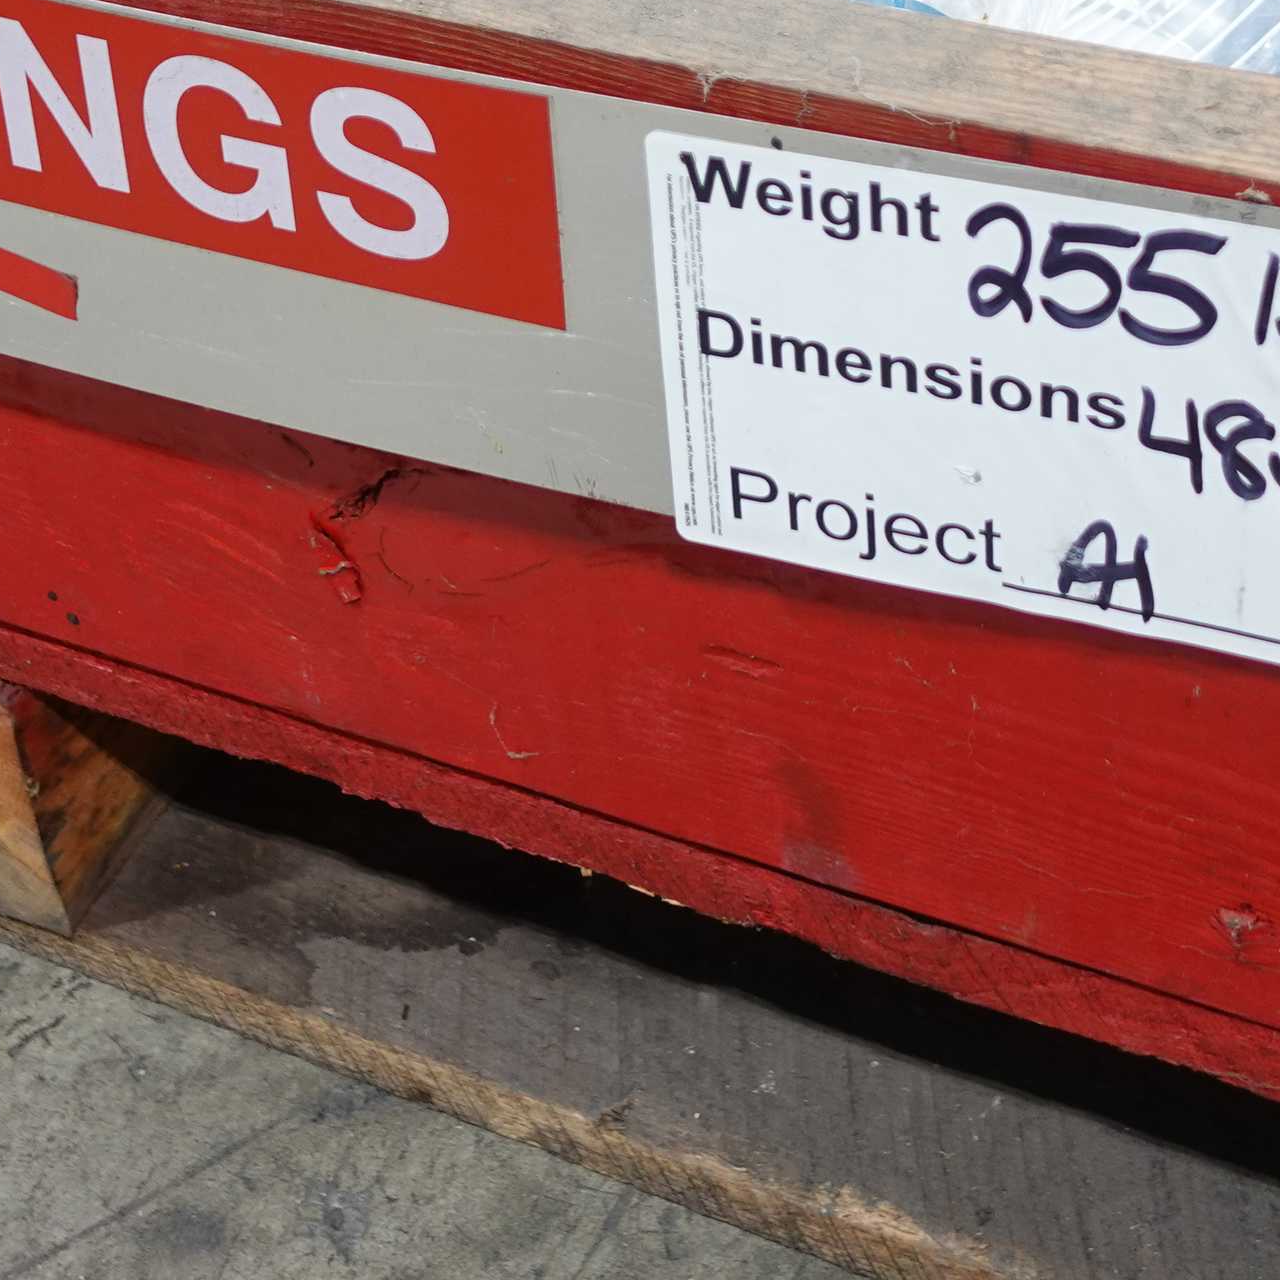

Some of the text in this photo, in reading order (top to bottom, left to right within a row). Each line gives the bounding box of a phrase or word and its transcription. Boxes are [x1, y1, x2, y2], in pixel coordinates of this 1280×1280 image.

[679, 150, 941, 242] Weight
[965, 201, 1228, 347] 255
[697, 307, 1127, 430] Dimensions
[729, 465, 1004, 573] Project
